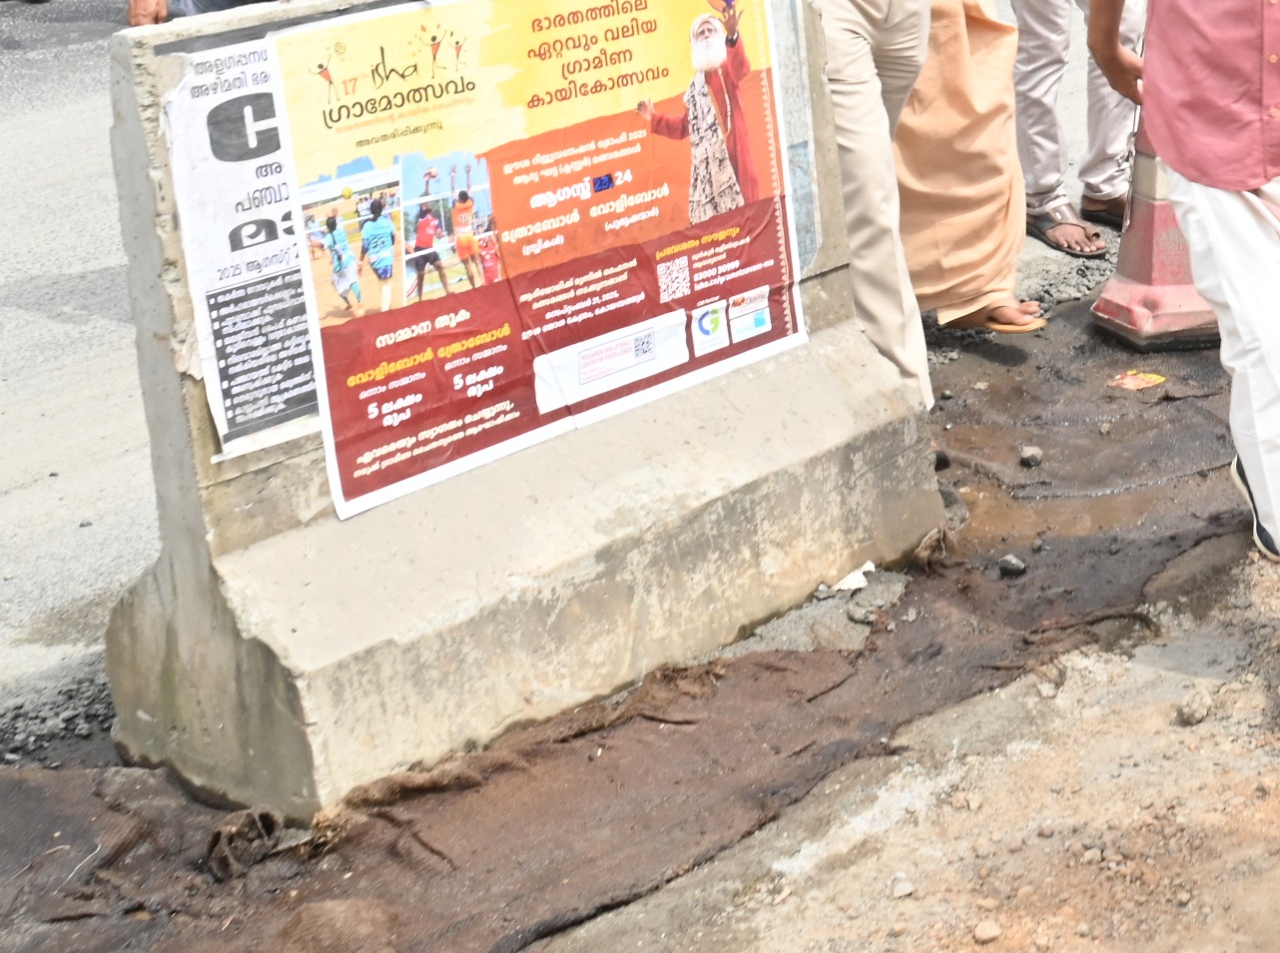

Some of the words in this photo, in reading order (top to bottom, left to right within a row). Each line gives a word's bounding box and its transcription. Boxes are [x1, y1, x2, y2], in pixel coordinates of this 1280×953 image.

[527, 34, 598, 61] ഏറ്റവും
[604, 17, 657, 42] വലിയ
[252, 70, 271, 86] ഭര
[370, 42, 418, 89] isha
[561, 48, 633, 80] ഗ്രാമീണ
[527, 66, 668, 109] കായികോത്സവം
[322, 76, 475, 129] ഗ്രാമോത്സവം
[255, 160, 283, 179] അ
[614, 169, 632, 185] 24
[234, 184, 289, 213] പഞ്ചാ
[452, 373, 464, 390] 5
[366, 401, 379, 420] 5
